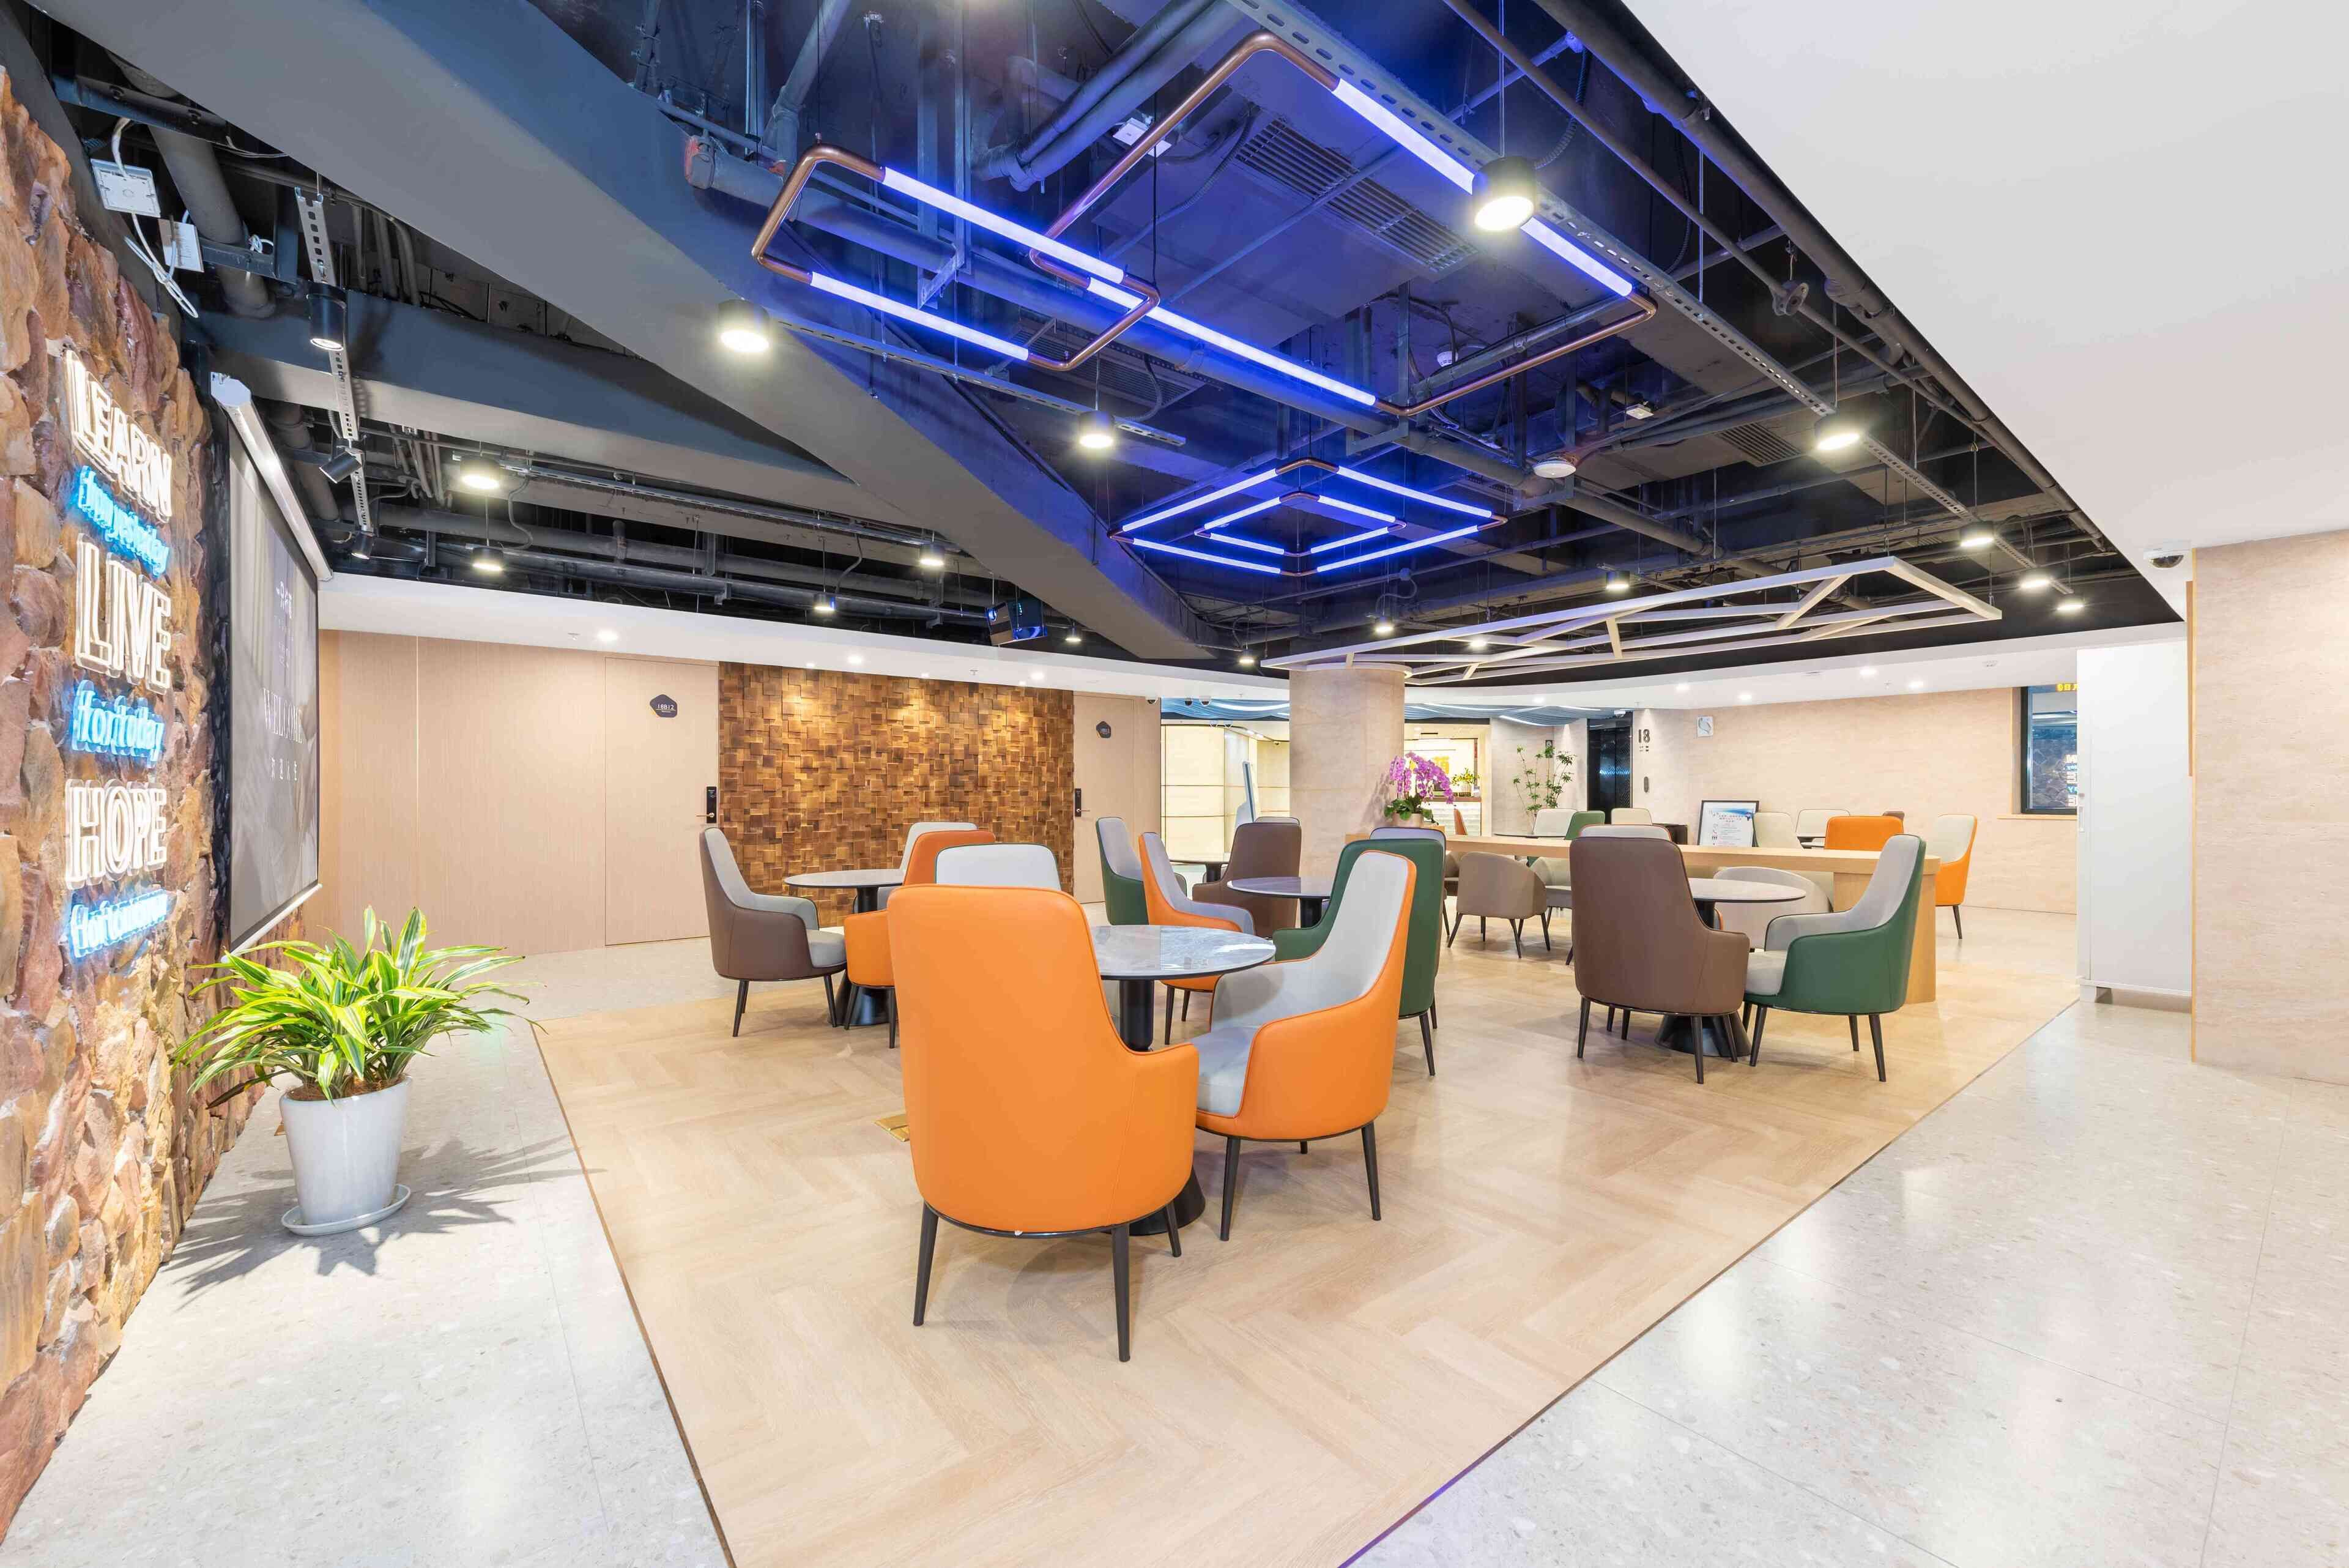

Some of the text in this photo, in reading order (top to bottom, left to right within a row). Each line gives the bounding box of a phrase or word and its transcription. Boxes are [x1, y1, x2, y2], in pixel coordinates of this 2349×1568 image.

[65, 350, 173, 523] LEARN
[75, 533, 171, 694] LIVE
[72, 680, 165, 768] for today
[263, 687, 303, 744] WELCOME
[1638, 729, 1650, 743] 18
[65, 779, 167, 890] HOPE
